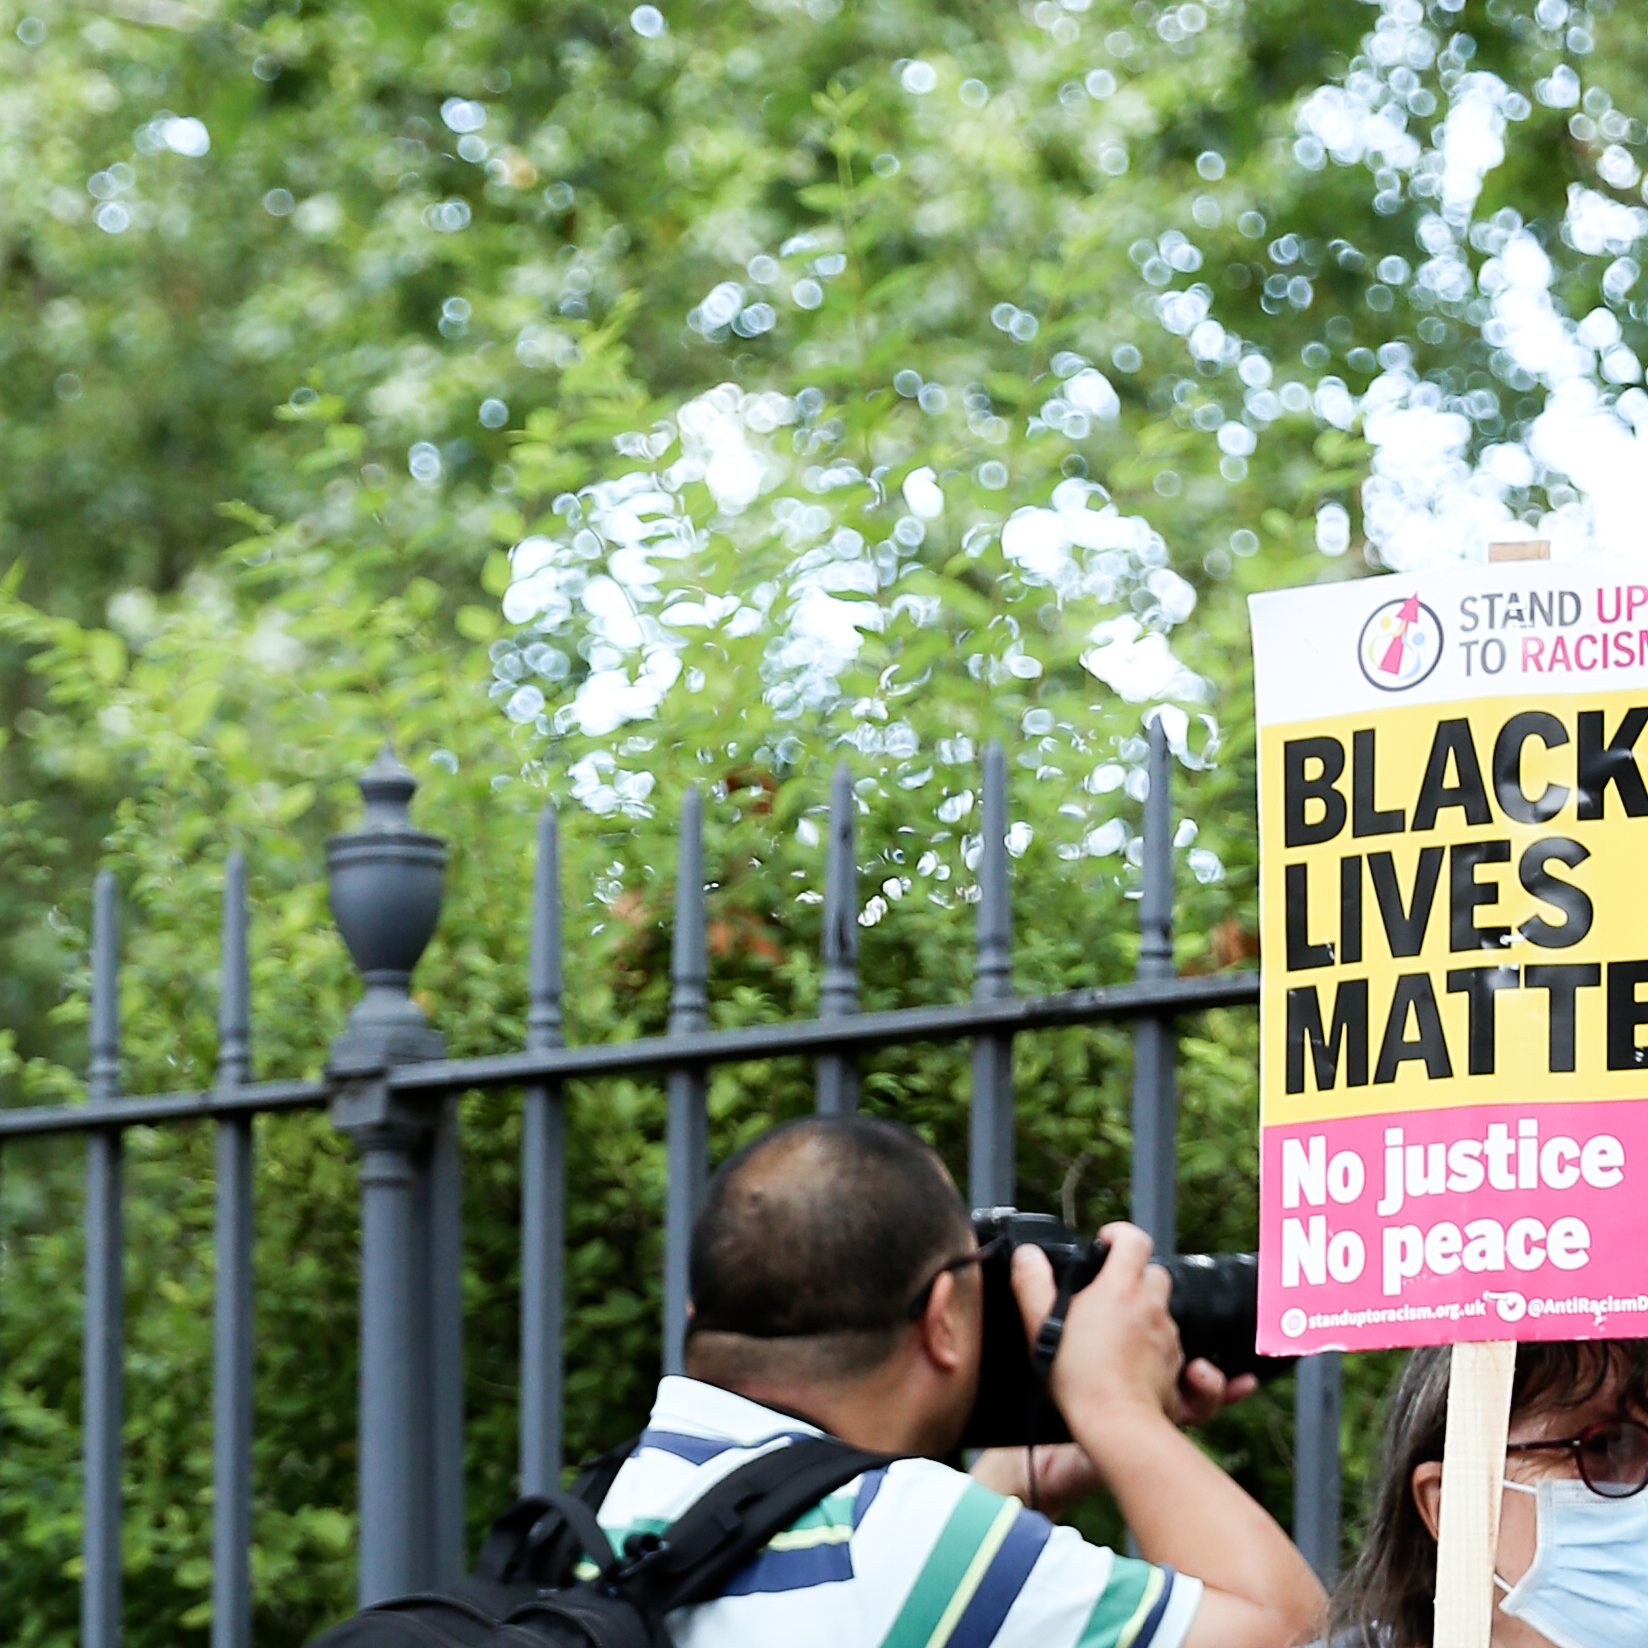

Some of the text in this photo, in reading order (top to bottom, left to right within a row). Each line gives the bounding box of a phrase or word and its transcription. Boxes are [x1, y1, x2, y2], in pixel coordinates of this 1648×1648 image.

[1459, 584, 1648, 633] STAND UP
[1458, 629, 1648, 678] TO RACIS
[1283, 706, 1648, 849] BLACK
[1283, 836, 1595, 972] LIVES
[1281, 1117, 1626, 1217] No justice
[1281, 1214, 1591, 1296] No peace
[1308, 1299, 1487, 1330] standuptoracism.org.uk
